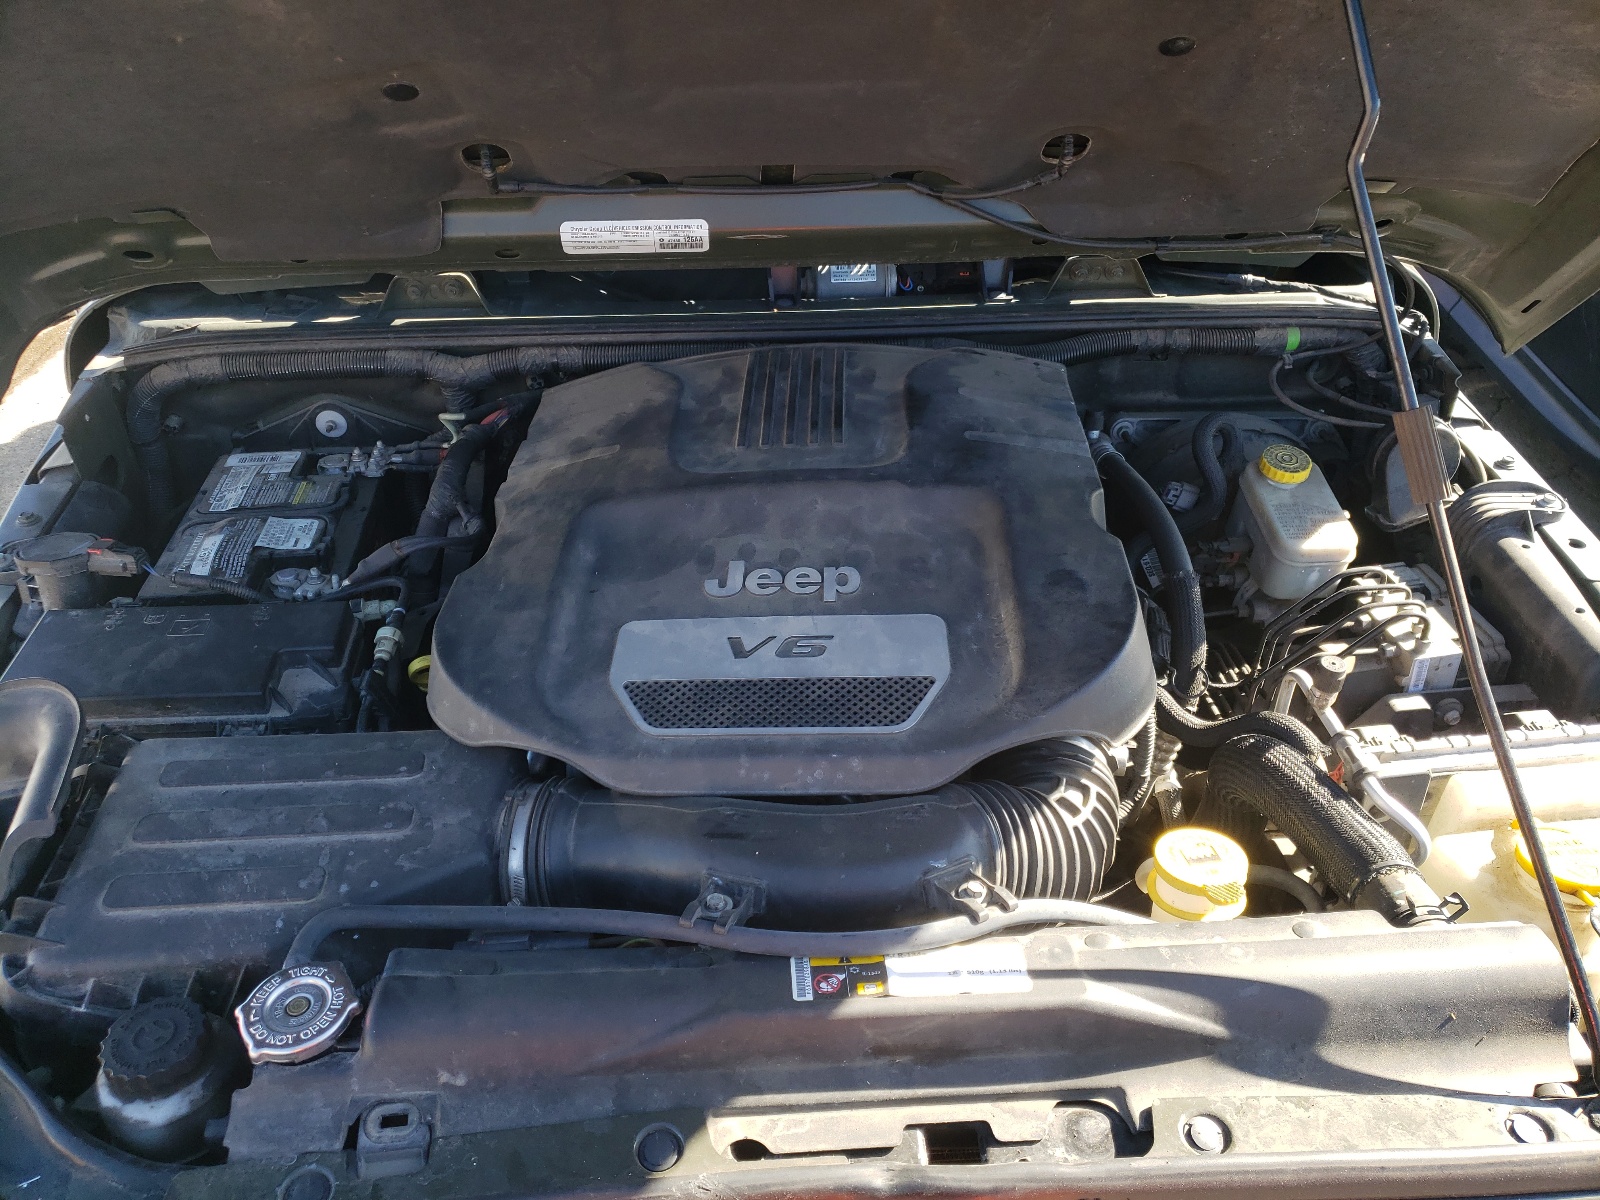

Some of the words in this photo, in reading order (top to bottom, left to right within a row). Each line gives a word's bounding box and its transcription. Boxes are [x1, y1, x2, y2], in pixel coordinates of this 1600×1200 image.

[704, 560, 861, 602] Jeep
[727, 634, 834, 660] V6
[250, 976, 282, 1006] KEEP
[288, 966, 328, 978] TIGHT
[249, 1024, 268, 1040] DO
[266, 1034, 297, 1045] NOT
[300, 1011, 338, 1040] OPEN
[330, 986, 345, 1009] HOT
